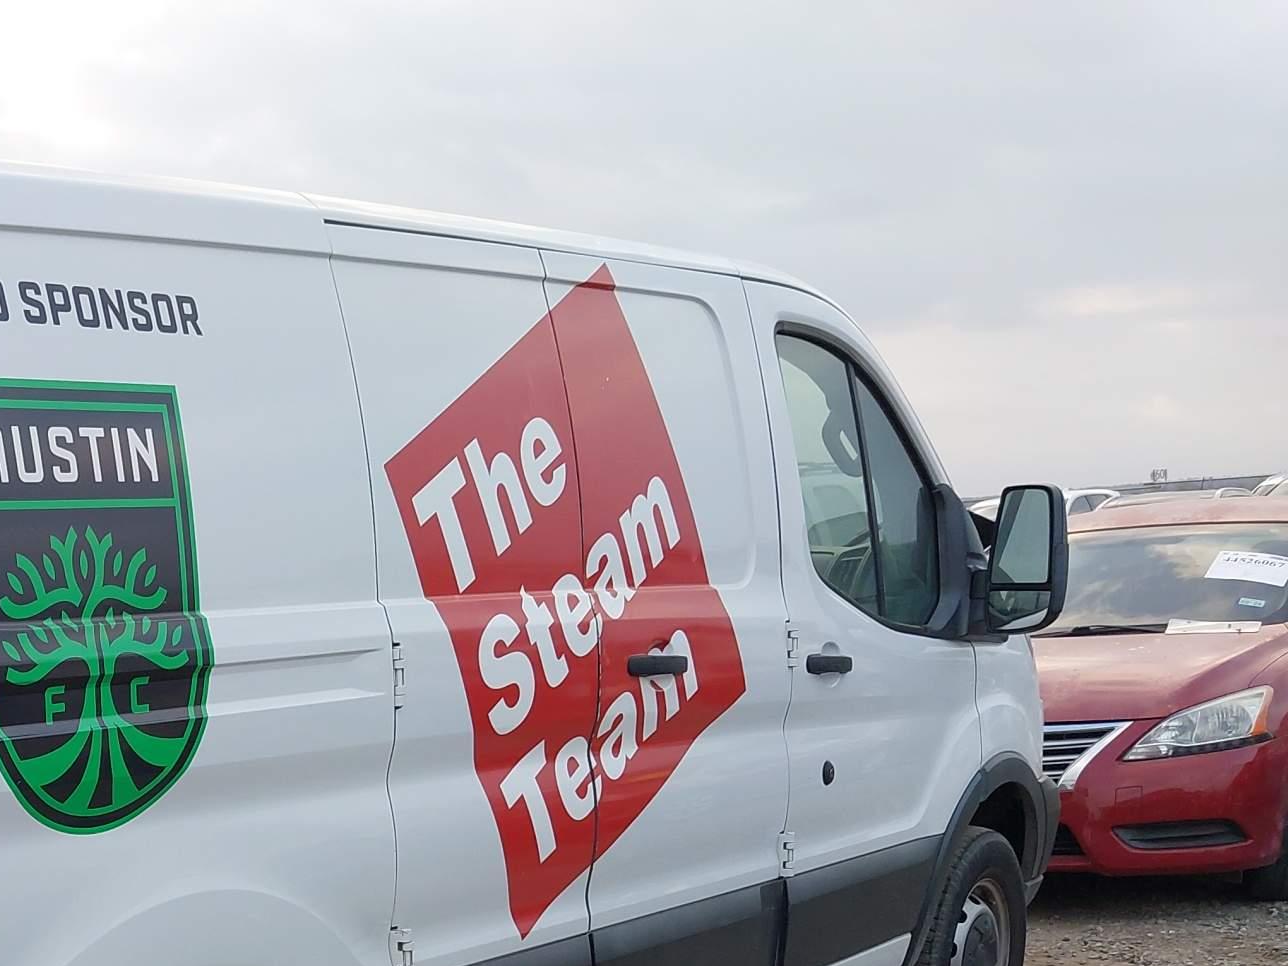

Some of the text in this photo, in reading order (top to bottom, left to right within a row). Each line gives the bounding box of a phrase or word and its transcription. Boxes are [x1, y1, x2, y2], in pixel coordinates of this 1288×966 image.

[18, 281, 204, 337] SPONSOR
[411, 416, 567, 594] The
[478, 476, 681, 736] Steam
[499, 629, 699, 865] Team
